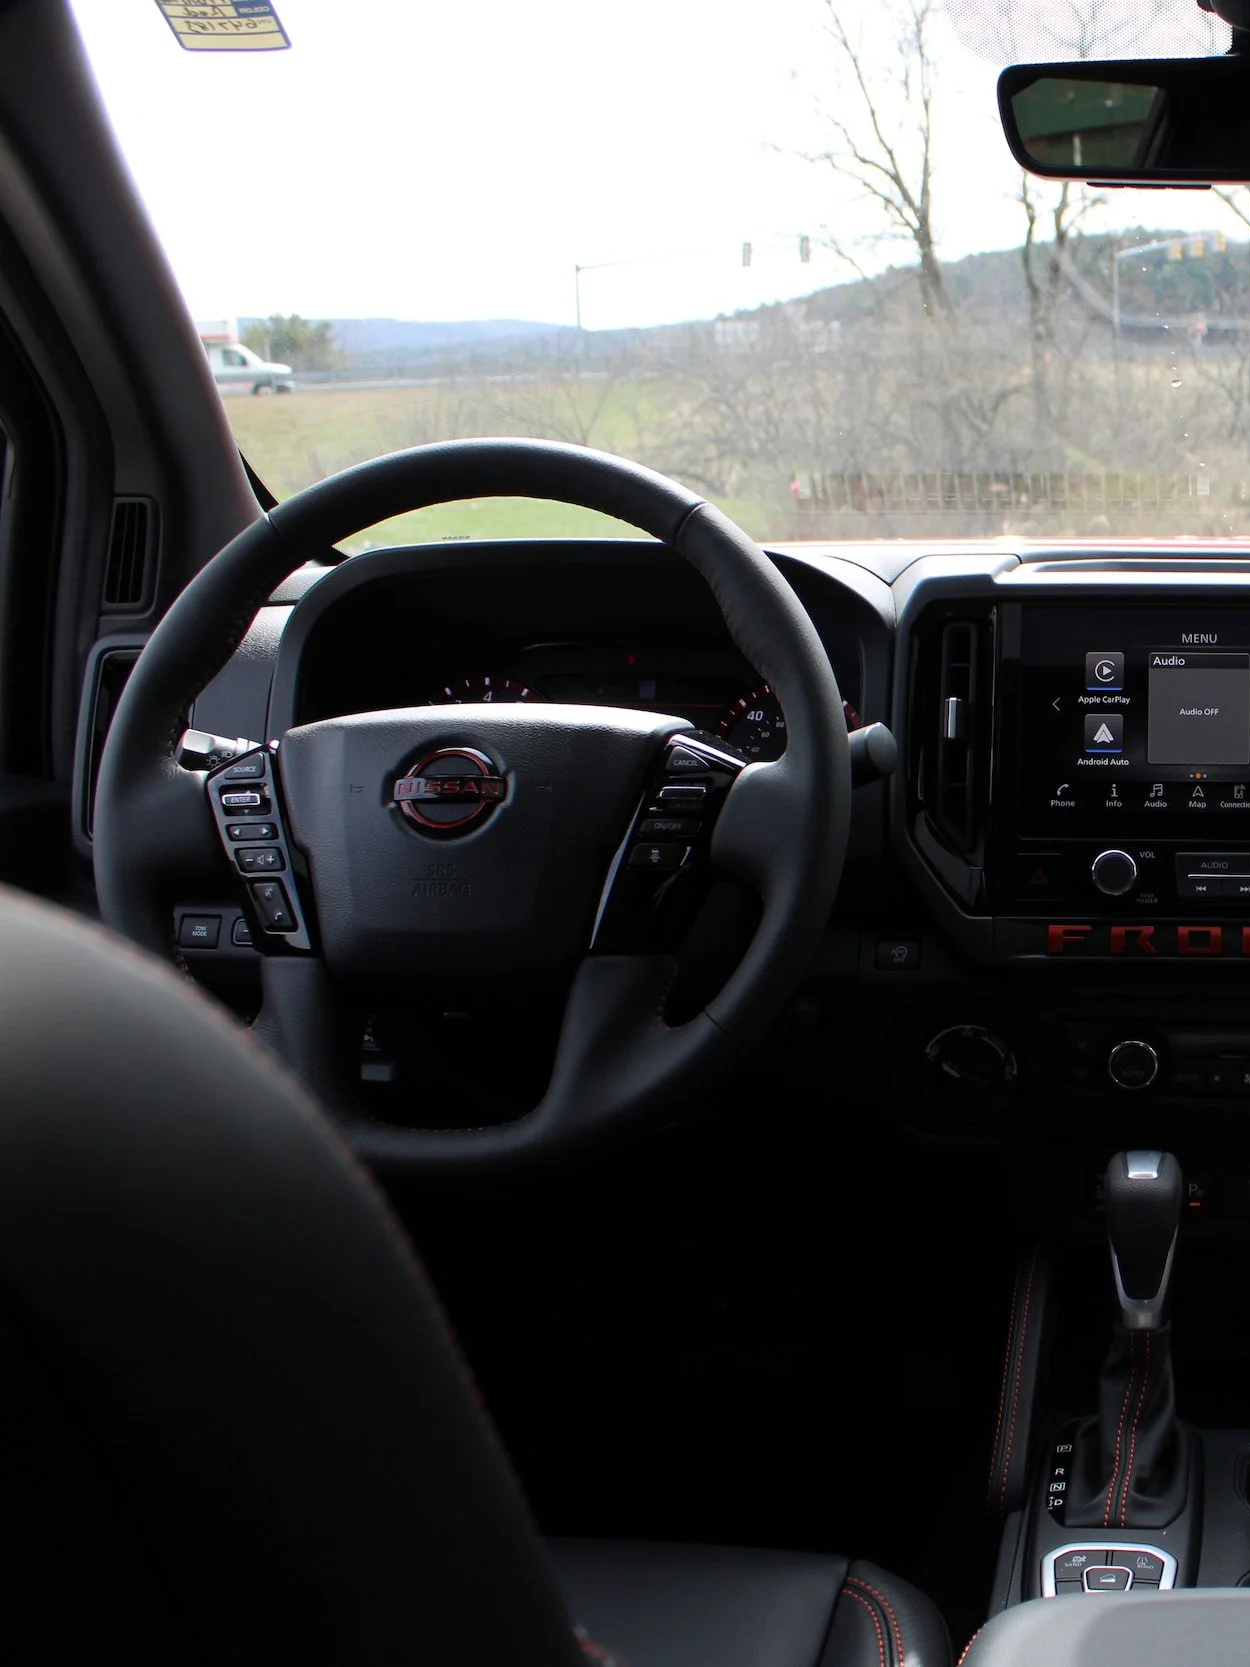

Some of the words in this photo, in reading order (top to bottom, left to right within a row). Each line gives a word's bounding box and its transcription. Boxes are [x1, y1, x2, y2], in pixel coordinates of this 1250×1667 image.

[1181, 633, 1218, 644] MENU
[1152, 655, 1186, 666] Audio
[483, 691, 493, 702] 4
[1077, 696, 1101, 705] Apple
[1102, 695, 1131, 705] CarPlay
[747, 710, 764, 721] 40
[1178, 707, 1203, 716] Audio
[1203, 708, 1219, 716] OFF
[673, 759, 700, 767] CANCEL
[1077, 758, 1109, 766] Android
[1109, 758, 1130, 766] Auto
[233, 765, 257, 773] SOURCE
[398, 779, 500, 795] NISSAN
[230, 796, 251, 804] ENTER
[1050, 799, 1076, 808] Phone
[1105, 800, 1123, 808] Info
[1143, 800, 1168, 808] Audio
[1188, 801, 1207, 810] Map
[1139, 851, 1156, 859] VOL
[1201, 861, 1229, 870] AUDIO
[413, 882, 472, 897] AIRBAG
[1055, 1468, 1065, 1476] R
